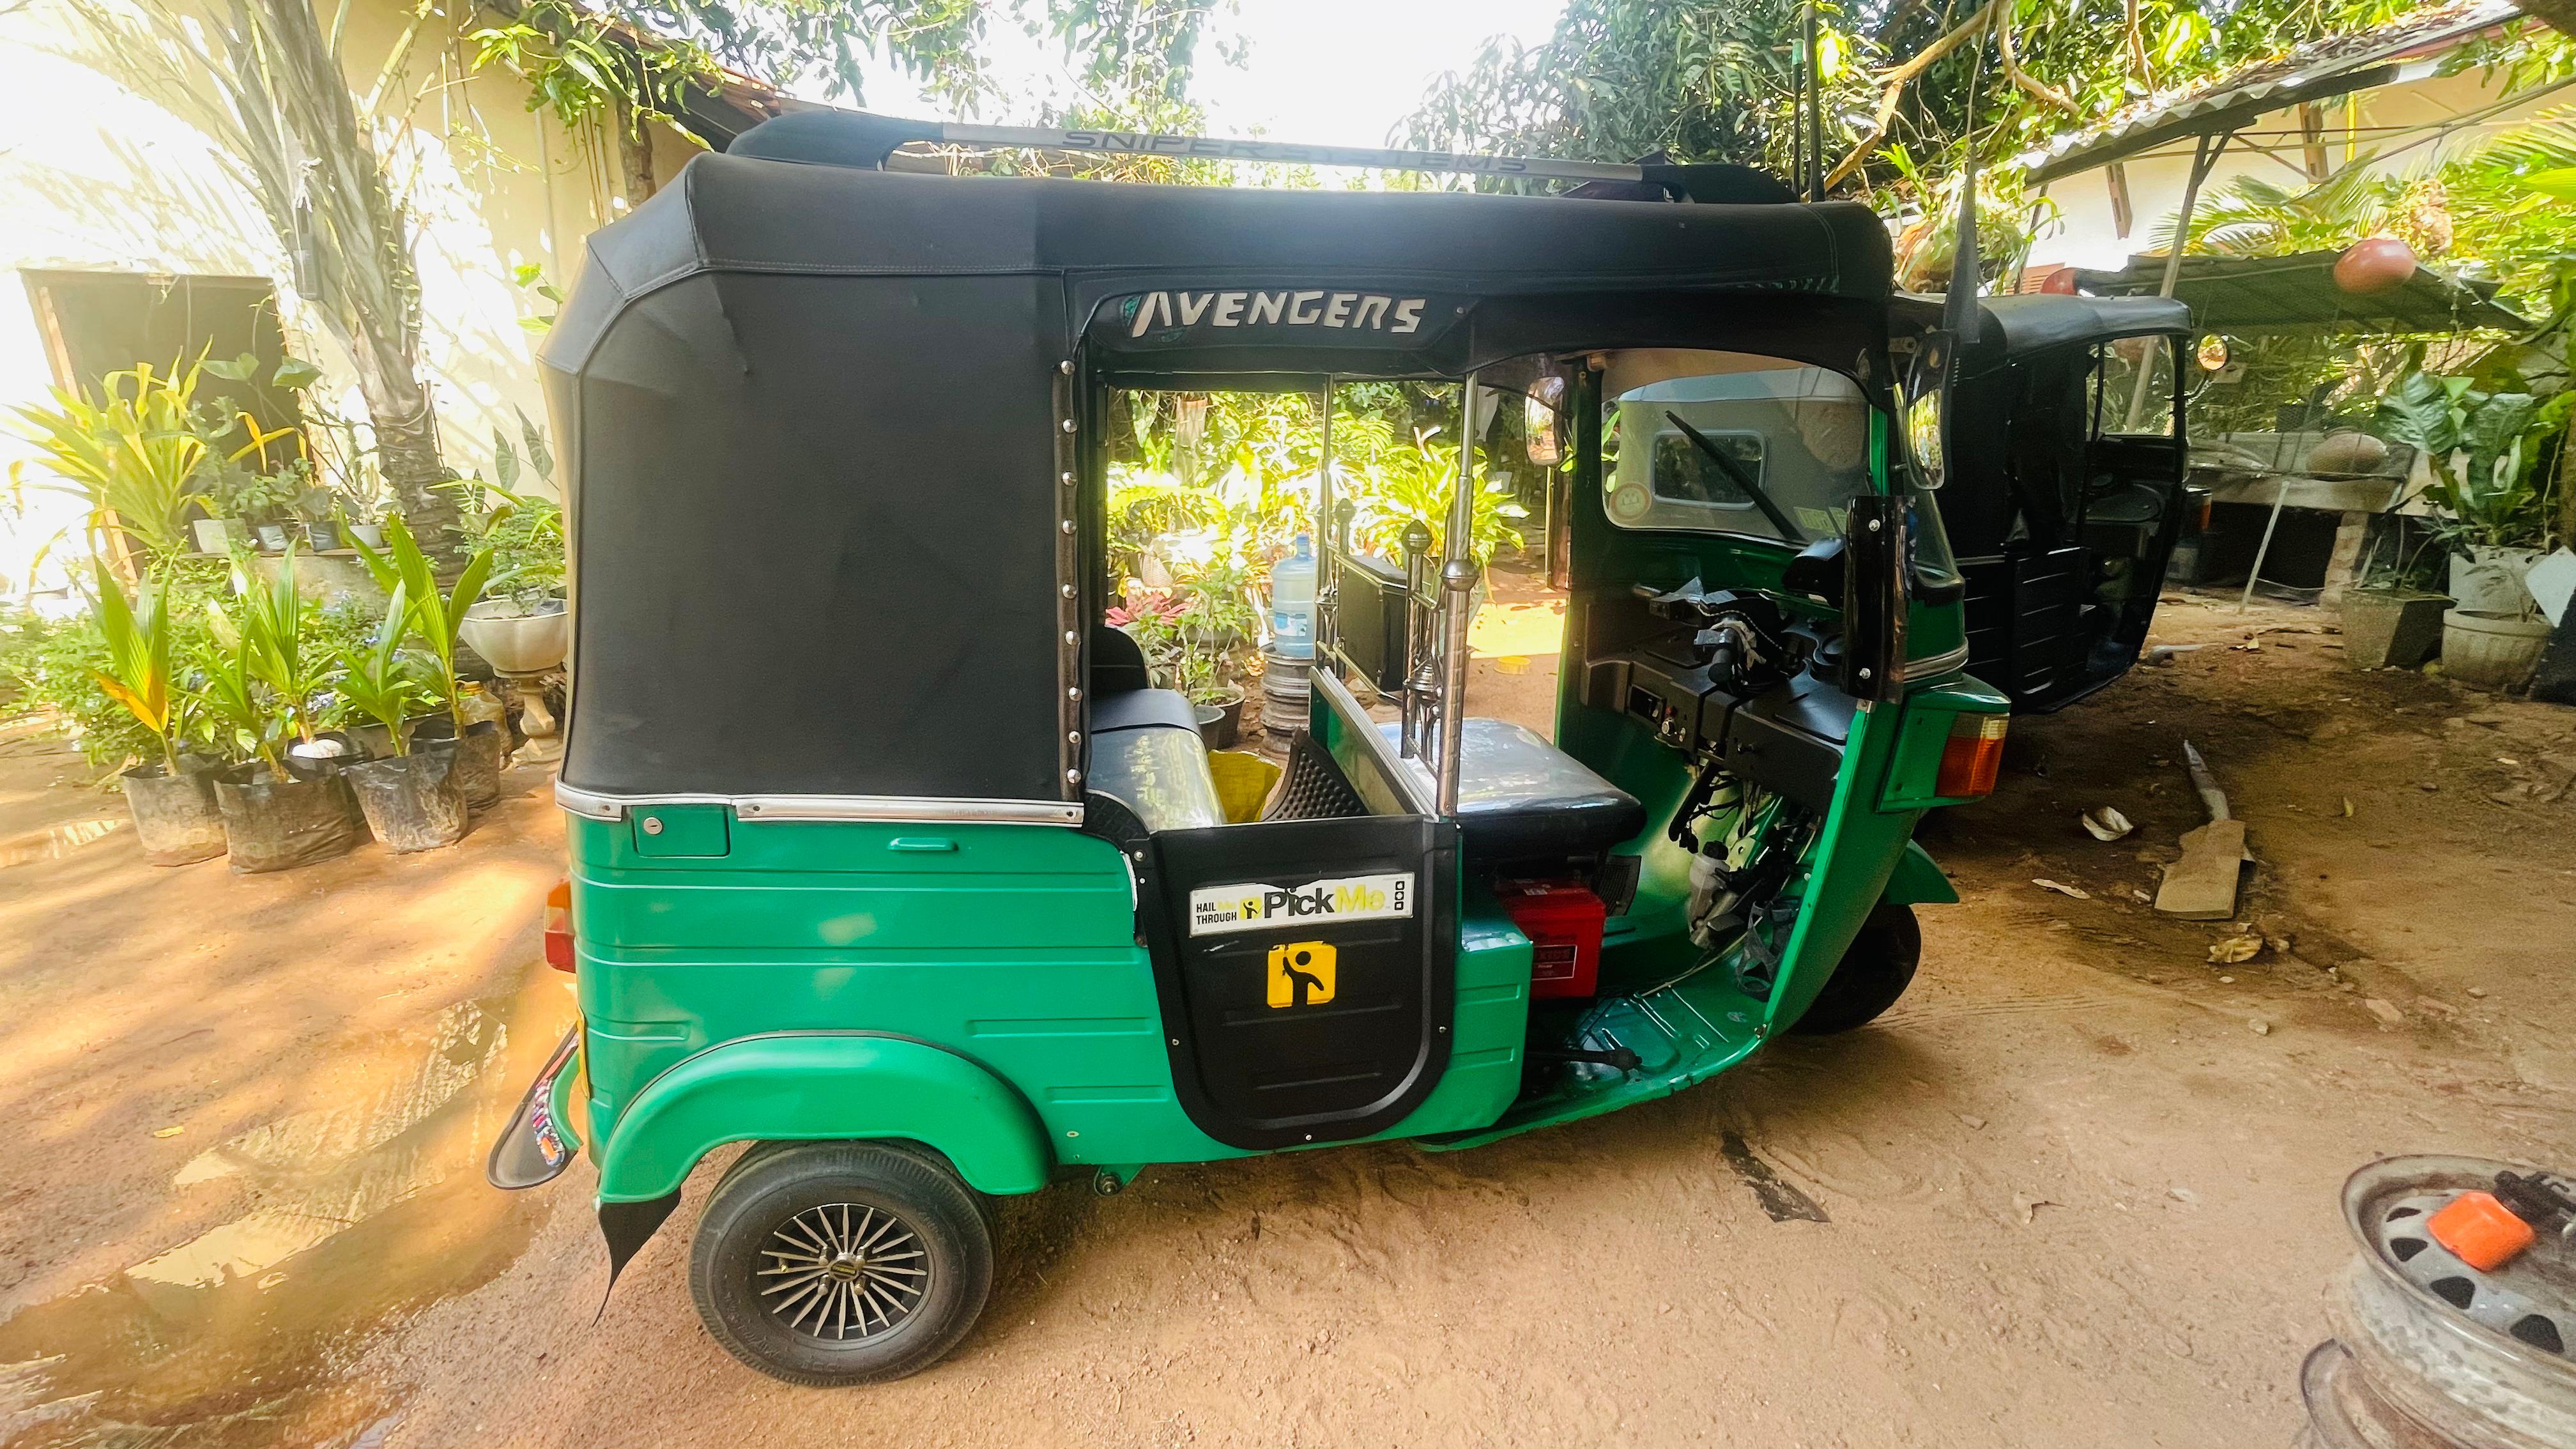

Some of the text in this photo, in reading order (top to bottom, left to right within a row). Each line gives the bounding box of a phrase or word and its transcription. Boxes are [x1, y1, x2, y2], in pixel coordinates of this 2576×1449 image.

[1062, 131, 1268, 157] SNIPER
[1131, 290, 1426, 338] AVENGERS
[1196, 903, 1216, 913] HAIL
[1264, 884, 1386, 919] PickMe
[1196, 912, 1237, 925] THROUGH
